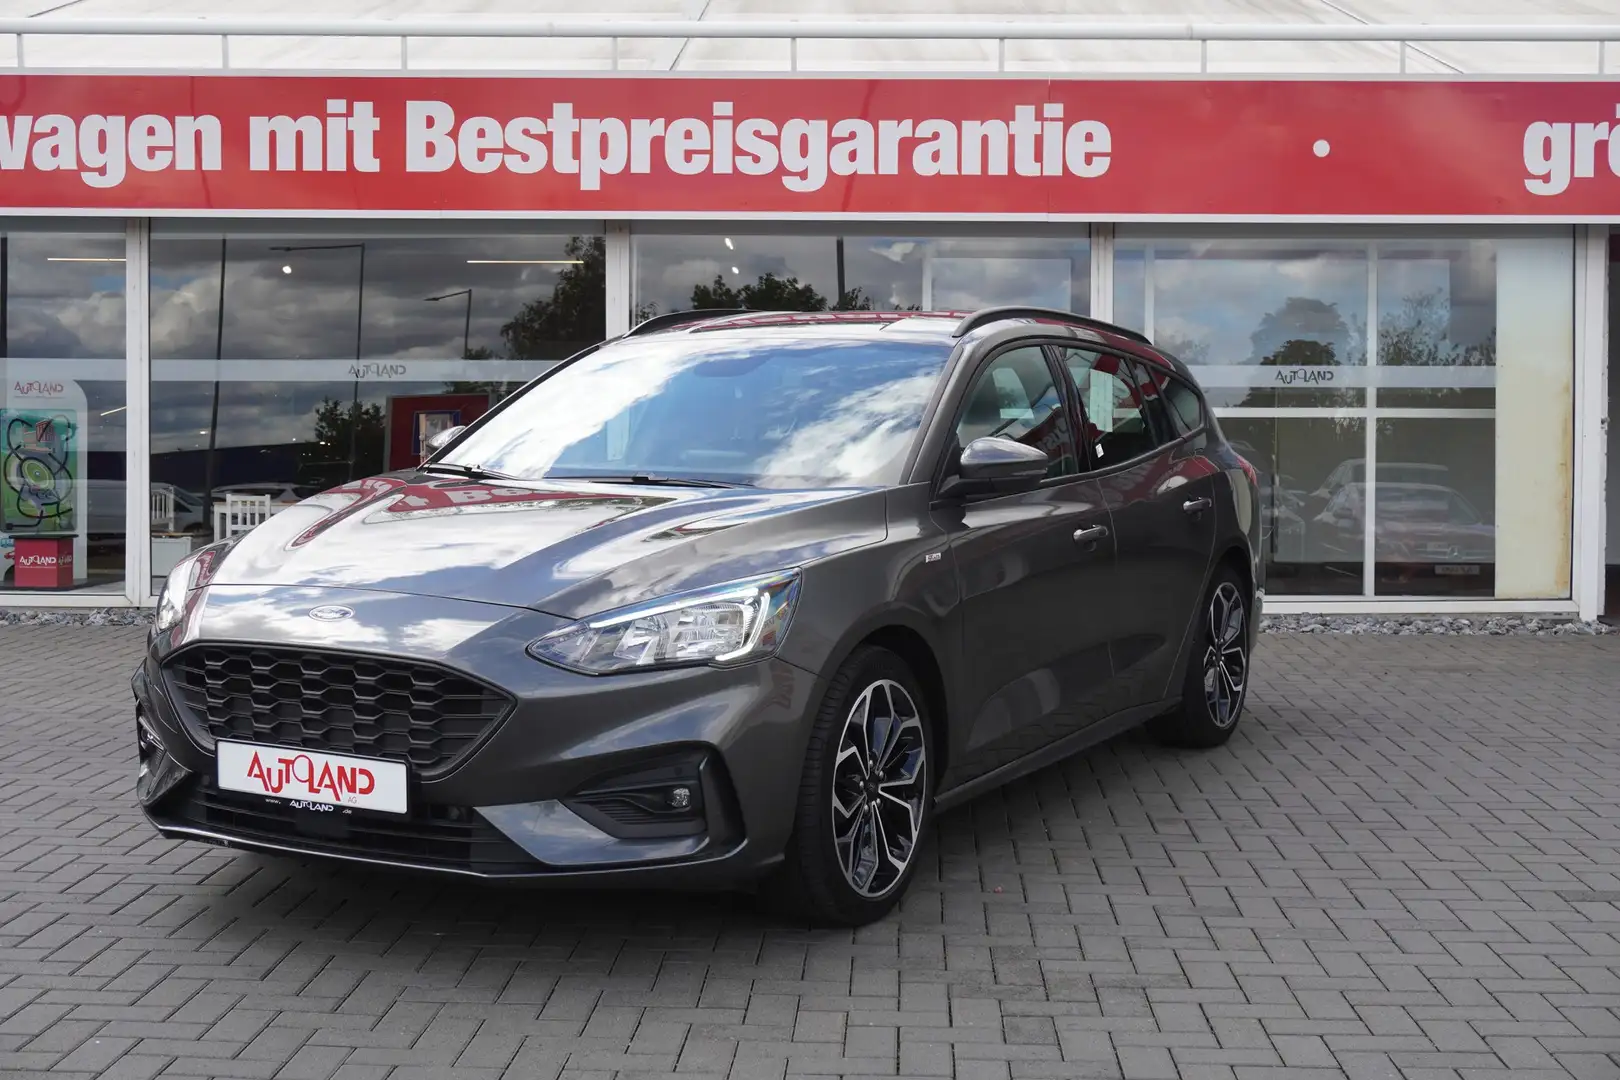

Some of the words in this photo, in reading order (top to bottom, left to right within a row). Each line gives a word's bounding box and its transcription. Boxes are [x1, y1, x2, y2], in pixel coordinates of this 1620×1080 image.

[0, 114, 222, 188] wagen
[249, 99, 380, 173] mit
[405, 100, 1112, 193] Bestpreisgarantie
[1523, 103, 1620, 196] gr
[349, 363, 406, 379] AUTOLAND
[1275, 368, 1334, 385] AUTOLAND
[14, 380, 64, 396] AUTOLAND
[19, 554, 57, 566] AUTOLAND
[247, 751, 376, 802] AUTOLAND
[289, 800, 334, 812] AUTOLAND
